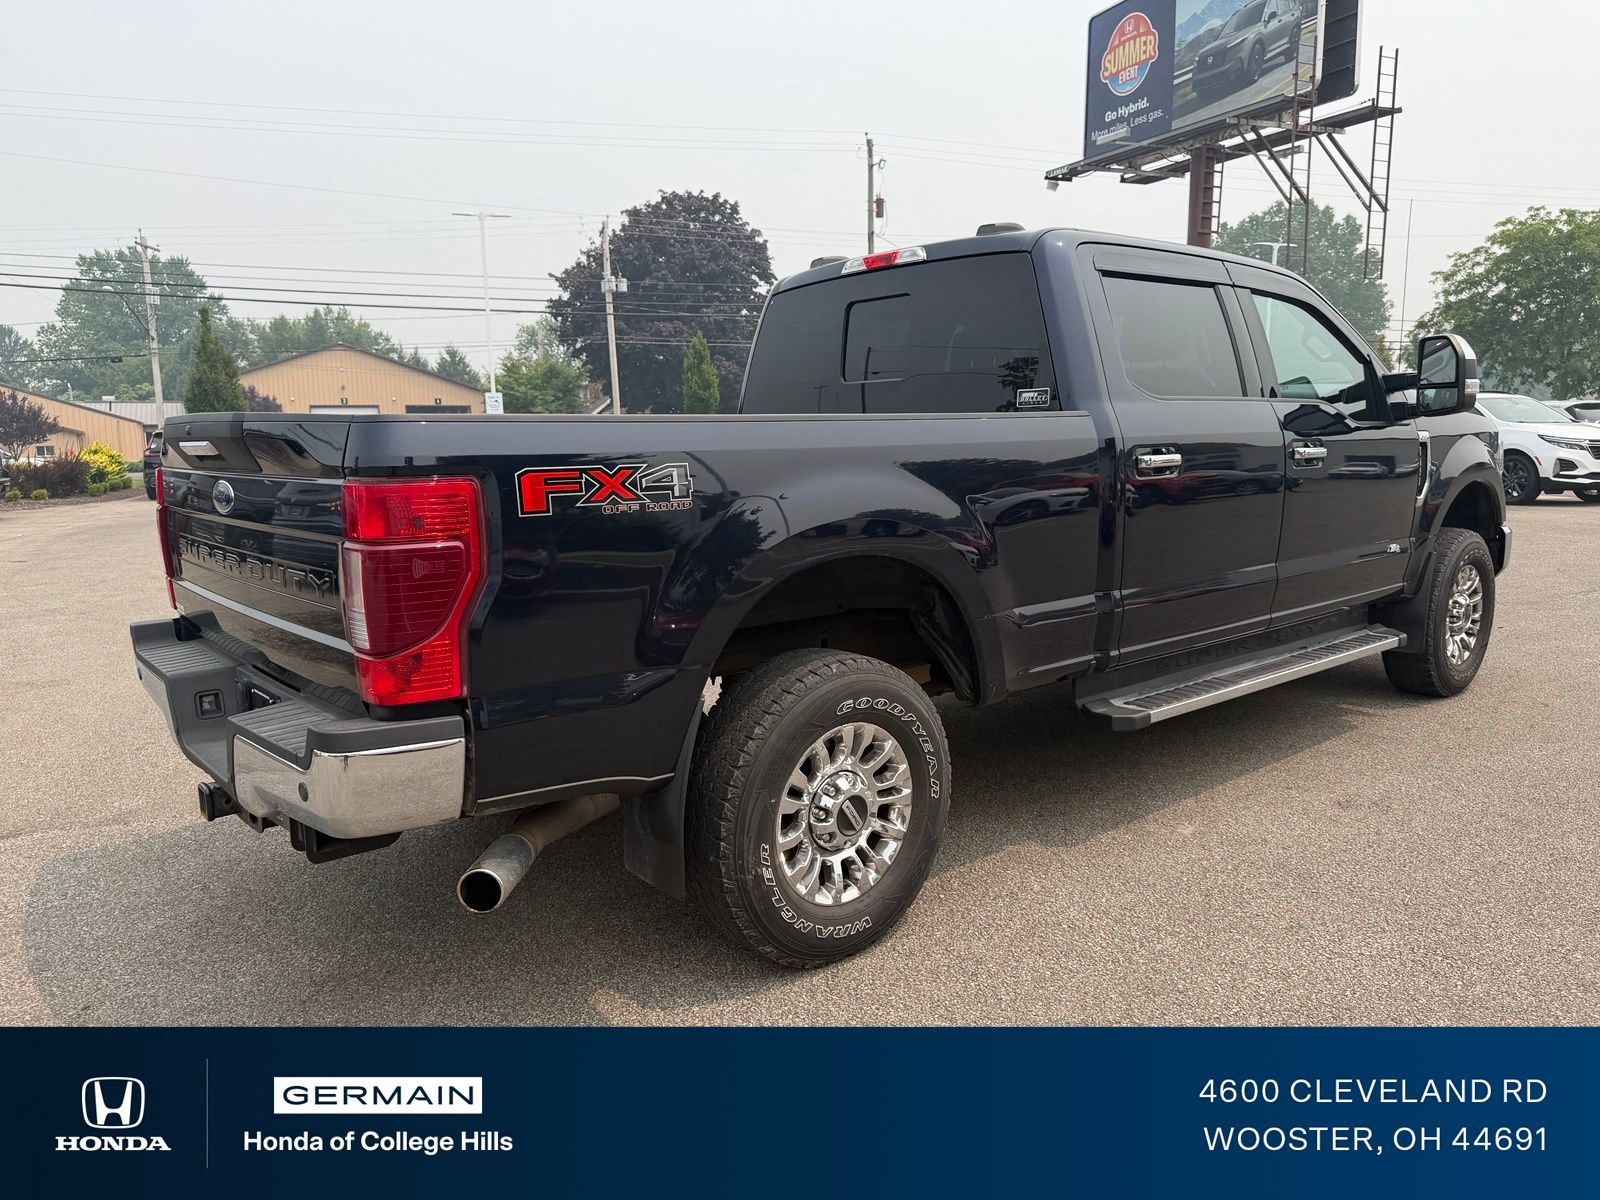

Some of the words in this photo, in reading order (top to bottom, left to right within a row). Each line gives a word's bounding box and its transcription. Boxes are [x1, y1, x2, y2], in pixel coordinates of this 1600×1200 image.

[1103, 35, 1155, 77] SUMMER
[1118, 65, 1139, 85] EVENT
[1105, 111, 1117, 122] Go
[1117, 97, 1150, 117] Hybrid.
[1130, 117, 1148, 127] Less
[1148, 109, 1164, 122] gas.
[515, 463, 693, 517] FX4
[602, 503, 640, 515] OFF
[646, 501, 693, 512] ROAD
[179, 537, 242, 576] SUPER
[246, 557, 331, 599] DUTY
[836, 696, 940, 800] GOODYEAR
[760, 843, 873, 938] WRANGLER
